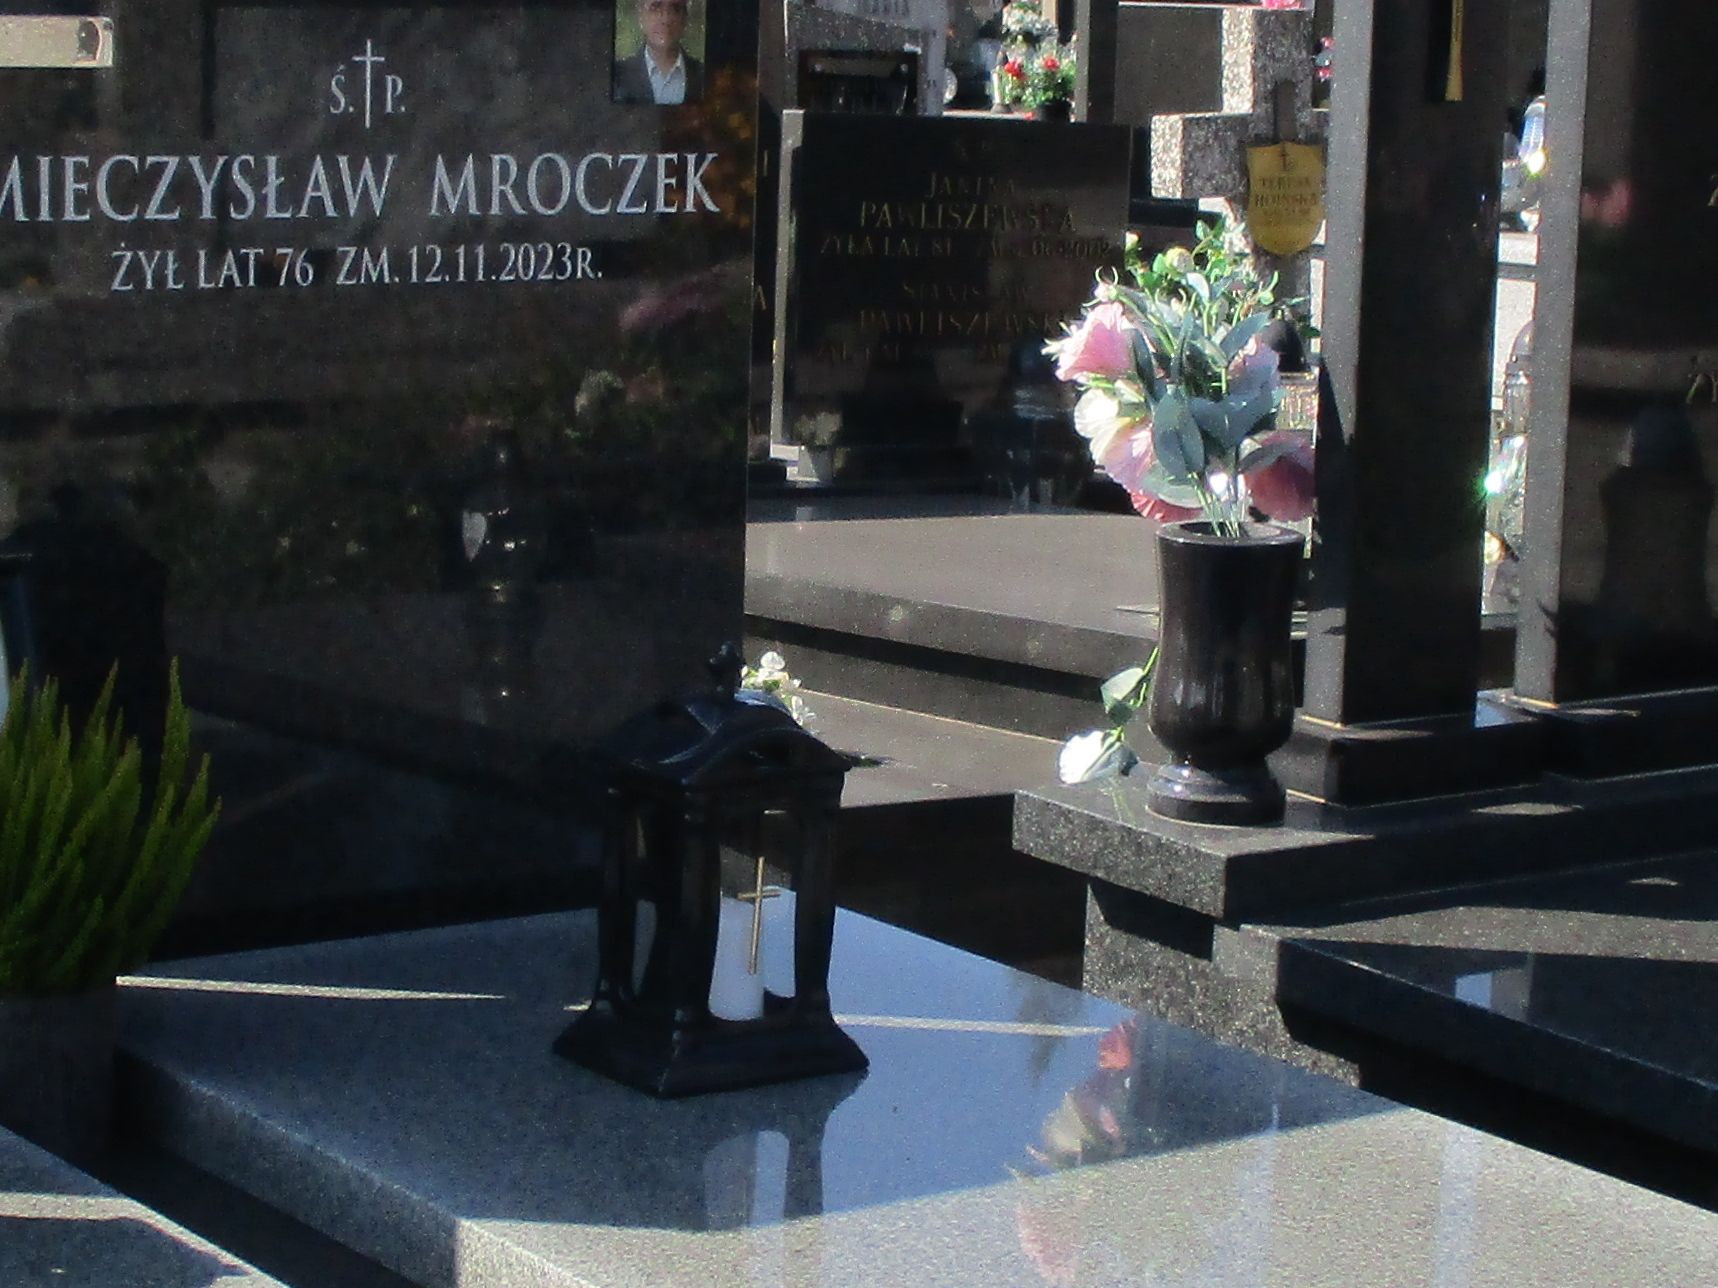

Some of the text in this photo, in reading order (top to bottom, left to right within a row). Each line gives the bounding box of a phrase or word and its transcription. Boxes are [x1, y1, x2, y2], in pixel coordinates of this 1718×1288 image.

[431, 153, 719, 215] MROCZEK
[112, 243, 183, 290] ŻYŁ
[199, 249, 264, 288] LAT
[277, 248, 313, 286] 76
